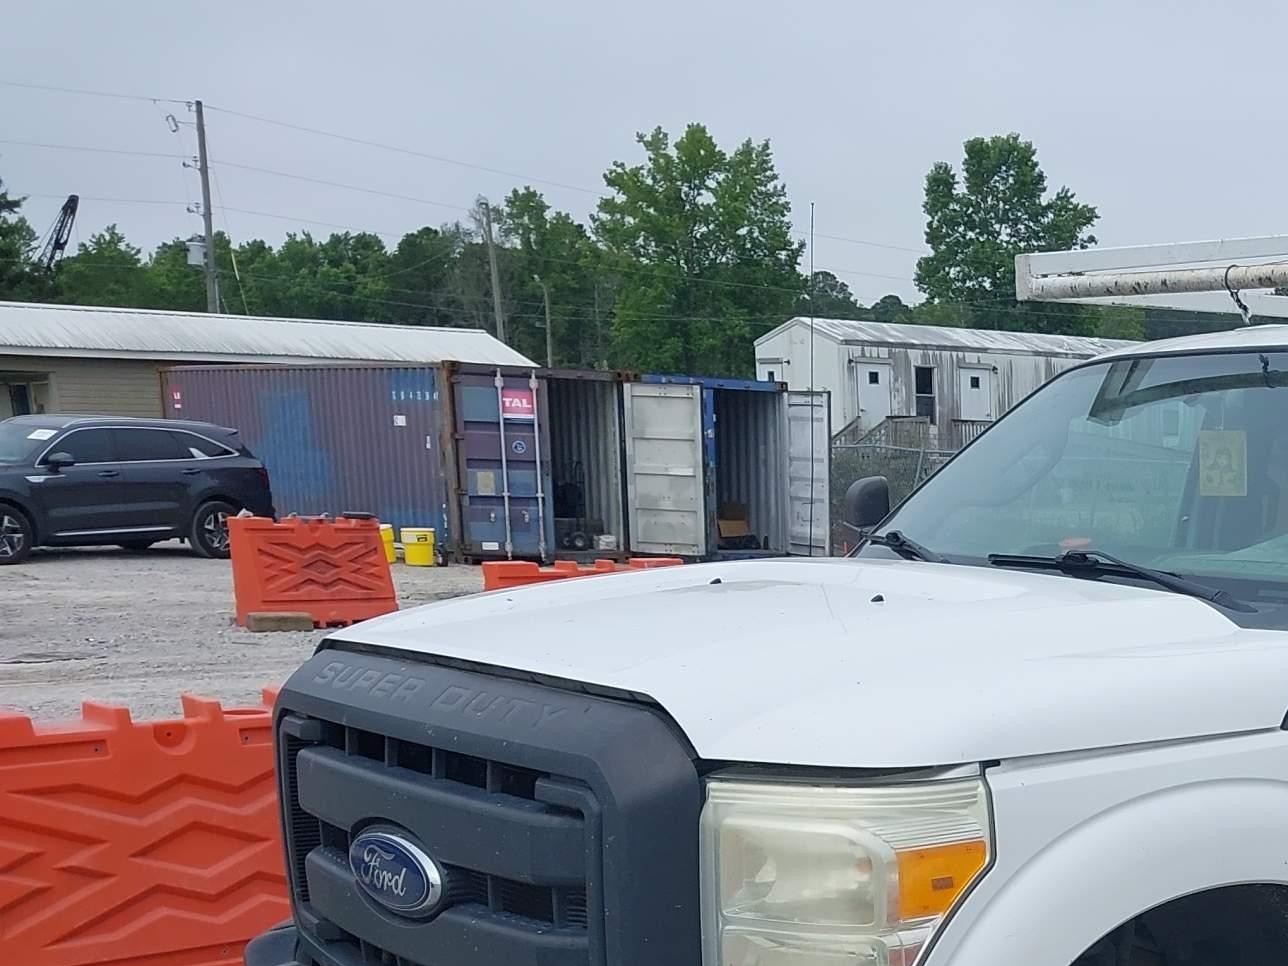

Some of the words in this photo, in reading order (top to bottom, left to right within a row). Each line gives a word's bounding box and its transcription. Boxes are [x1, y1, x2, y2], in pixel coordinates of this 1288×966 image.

[502, 397, 532, 408] TAL
[313, 660, 426, 704] SUPER
[431, 686, 567, 729] DUTY
[360, 844, 408, 897] Ford
